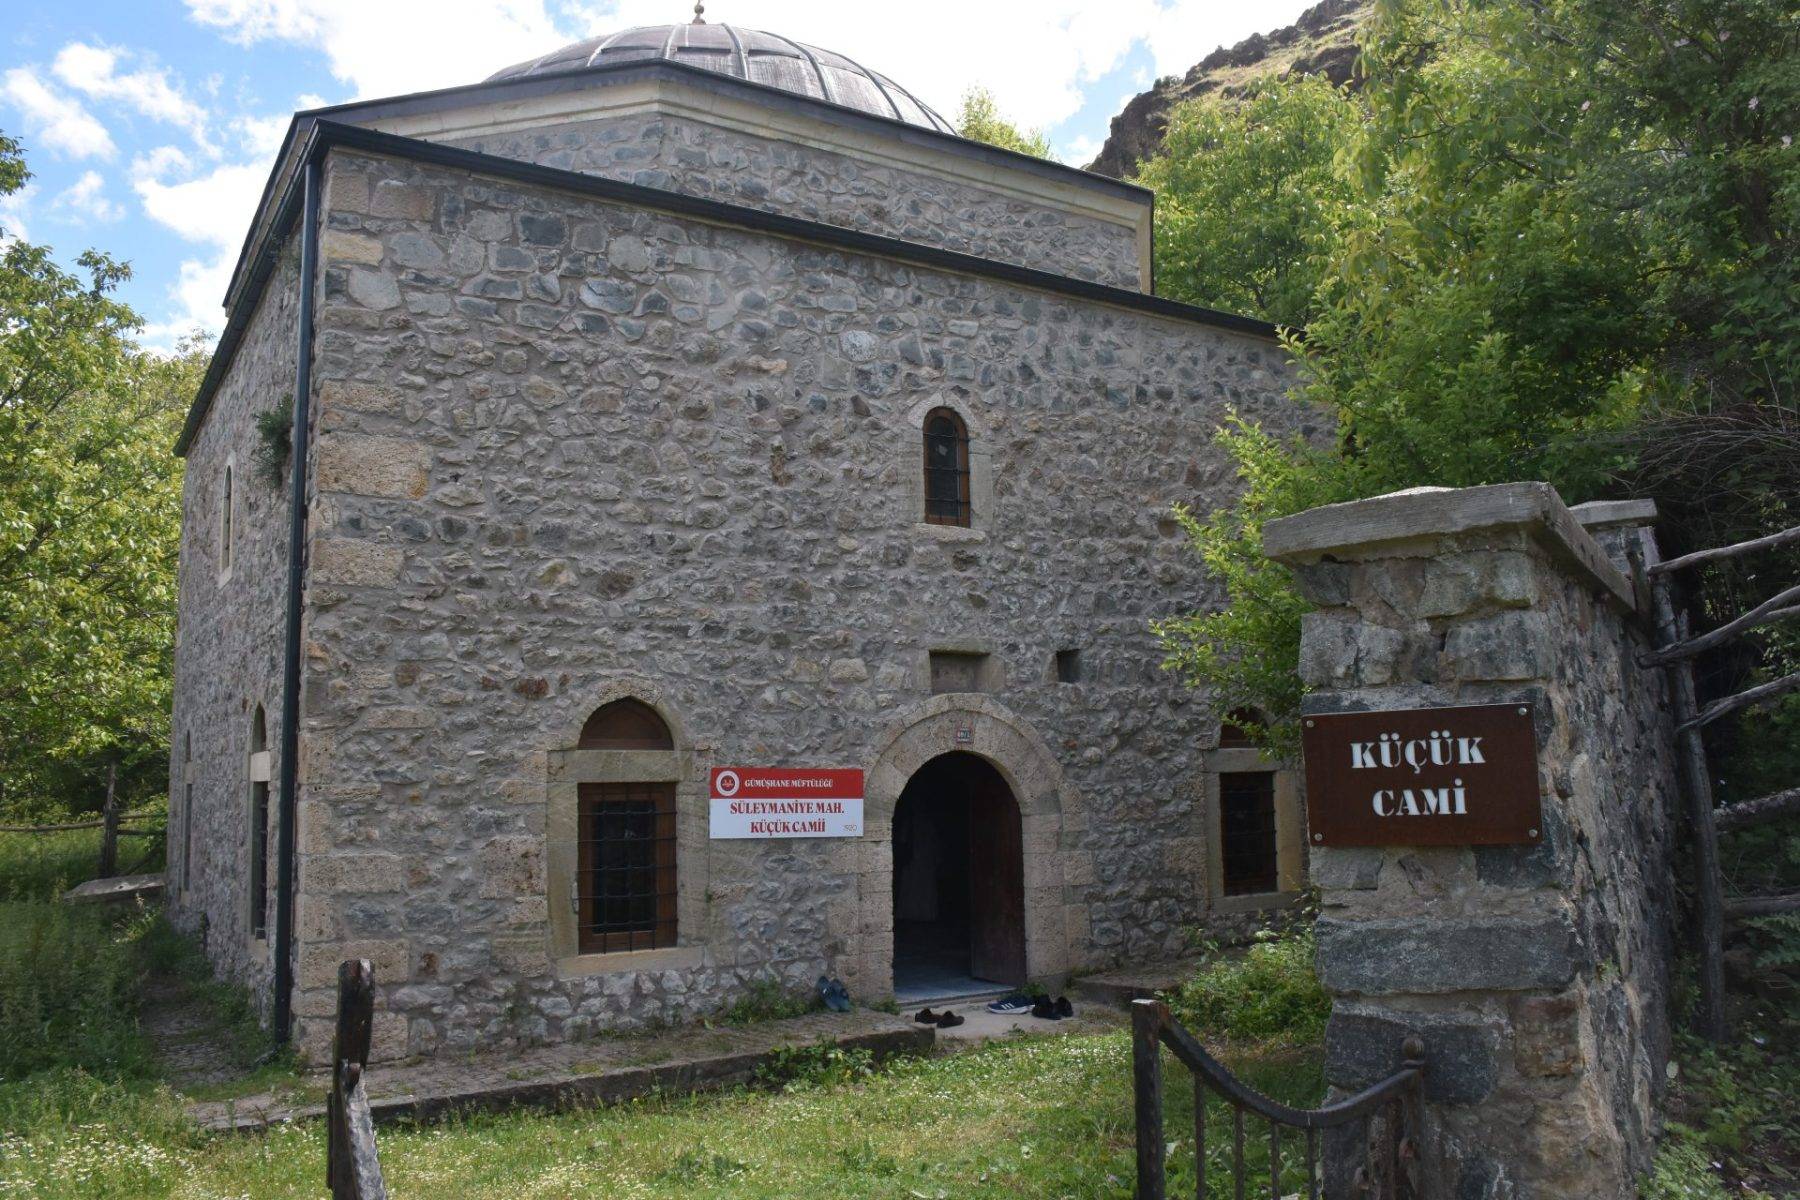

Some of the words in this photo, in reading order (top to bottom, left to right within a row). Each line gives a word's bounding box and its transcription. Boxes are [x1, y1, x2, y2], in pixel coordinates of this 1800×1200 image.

[1351, 730, 1486, 774] KÜÇÜK
[745, 778, 790, 789] GÜMÜŞHANE
[791, 778, 833, 788] MÜFTÜLÜĞÜ
[1372, 778, 1467, 816] CAMİ
[730, 800, 813, 814] SÜLEYMANİYE
[815, 803, 844, 814] MAH.
[750, 819, 790, 836] KÜÇÜK
[792, 818, 826, 832] CAMİİ
